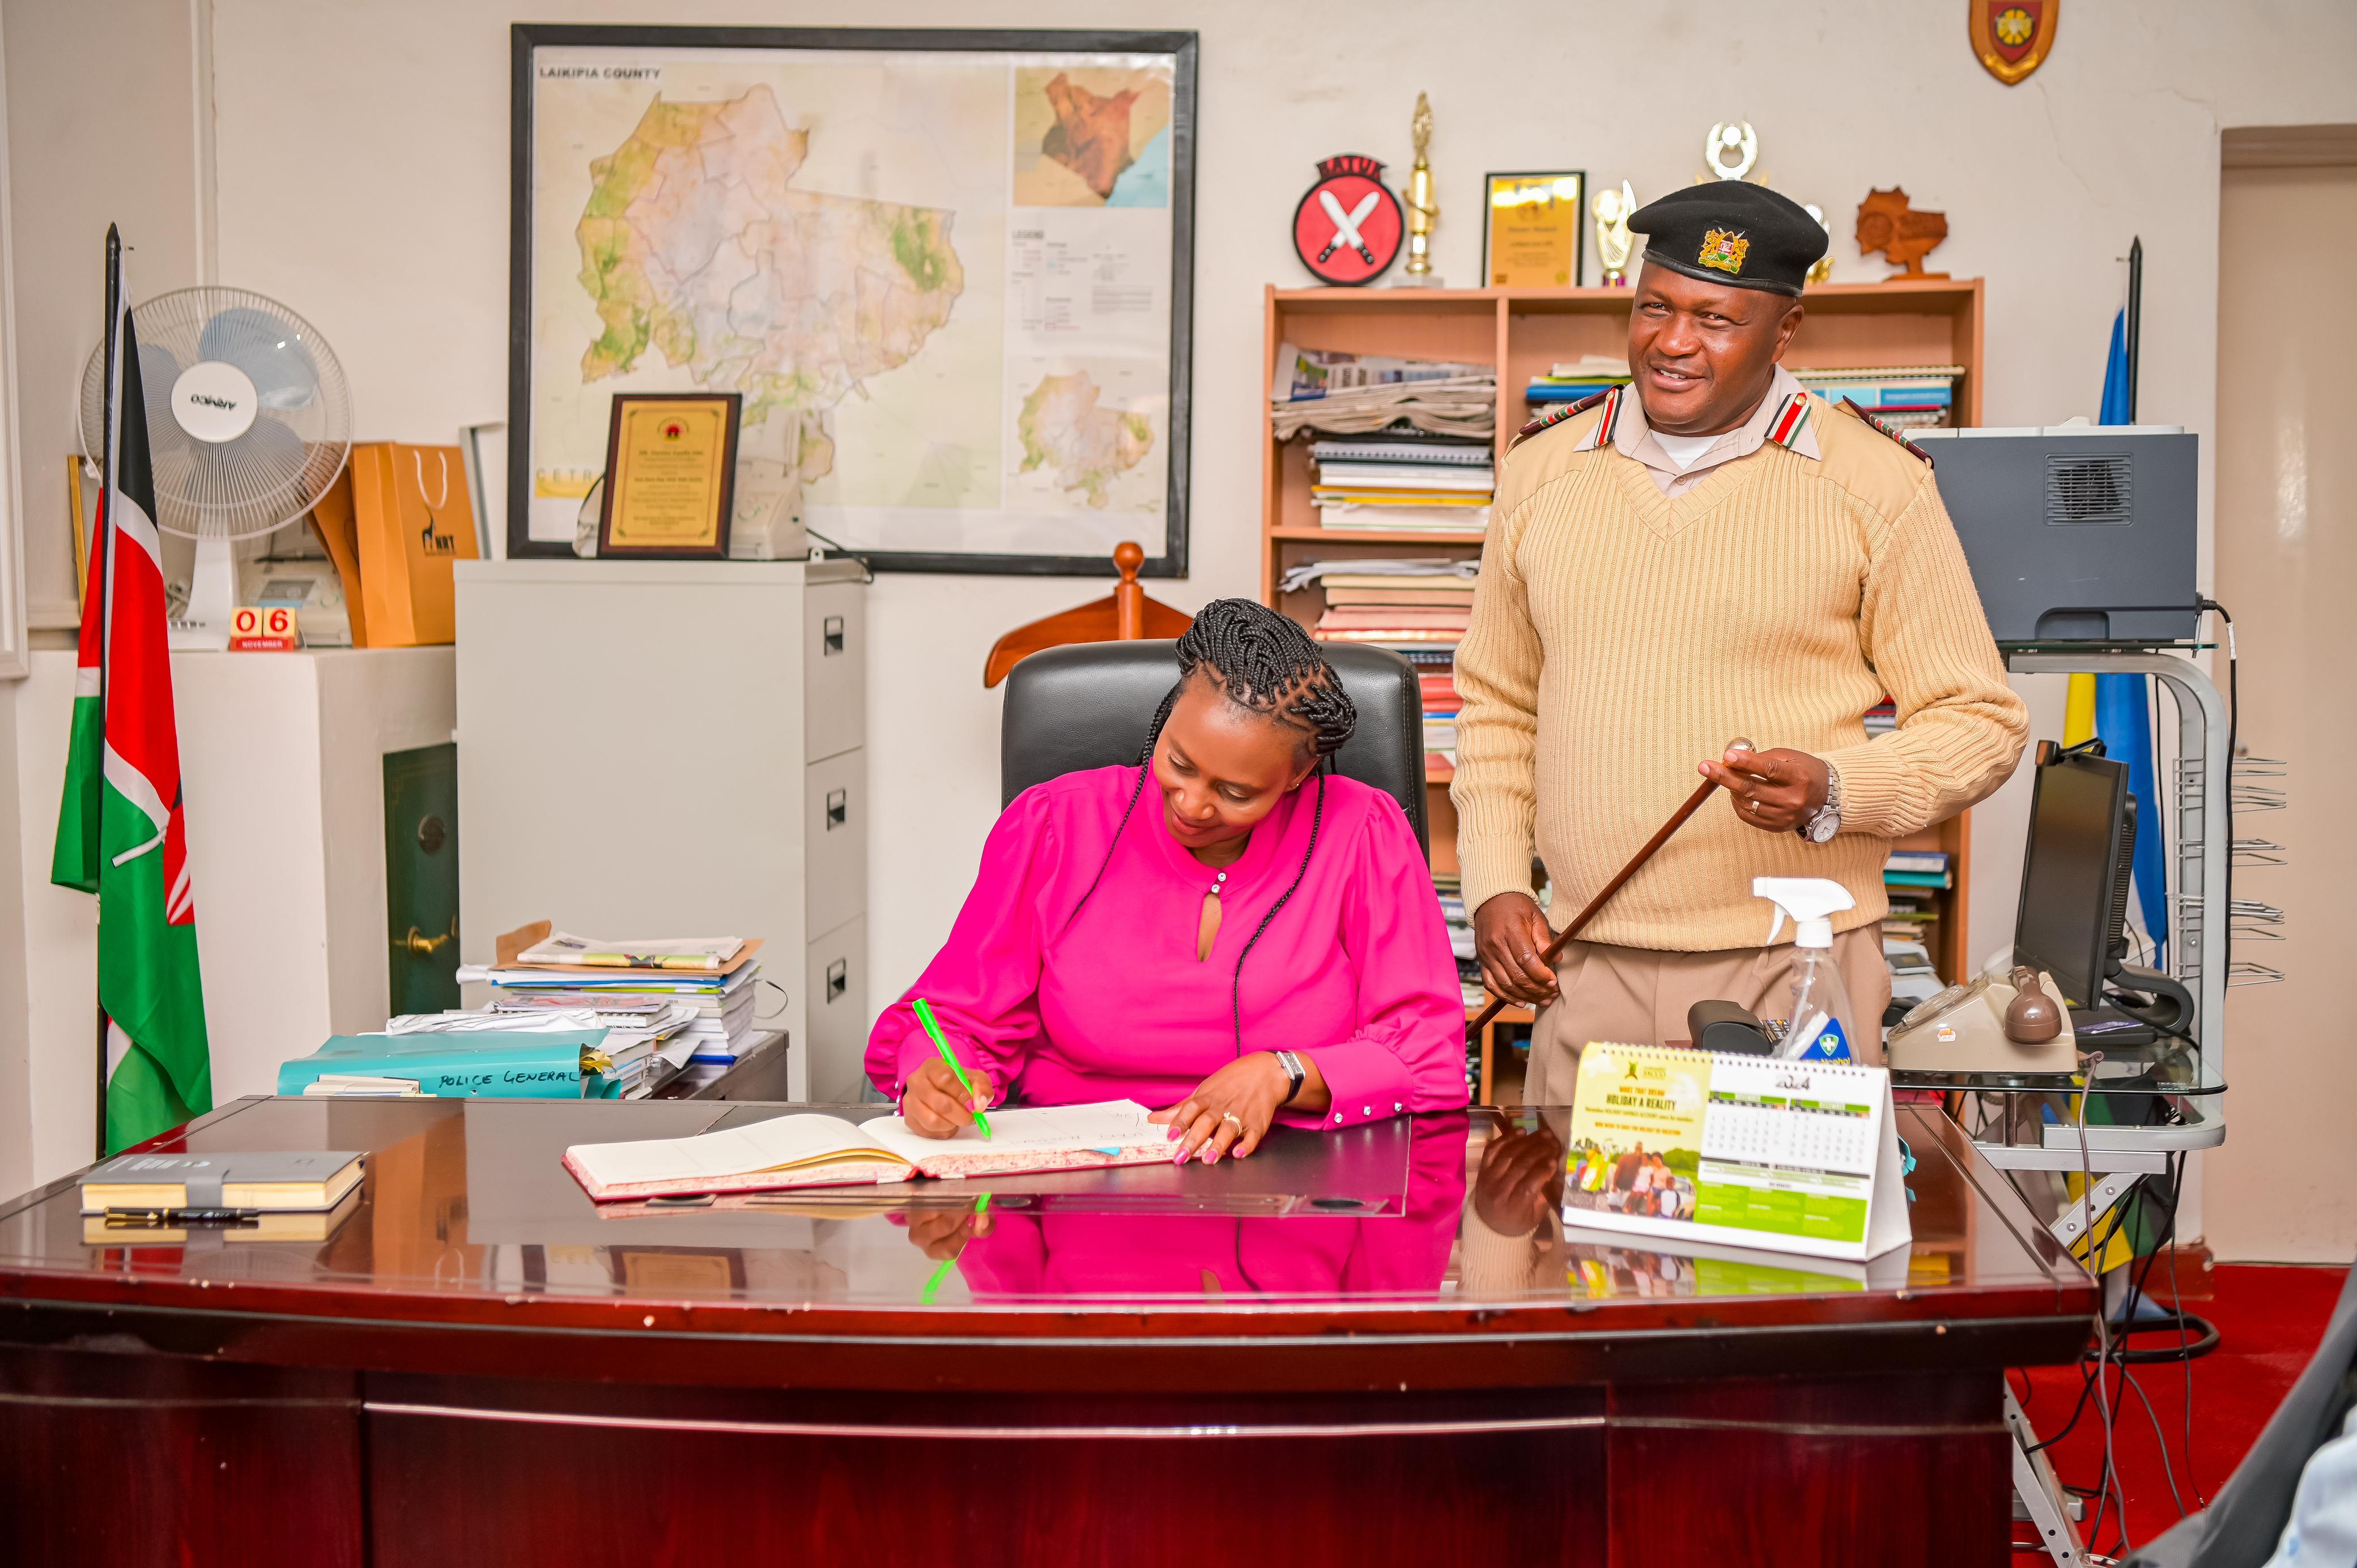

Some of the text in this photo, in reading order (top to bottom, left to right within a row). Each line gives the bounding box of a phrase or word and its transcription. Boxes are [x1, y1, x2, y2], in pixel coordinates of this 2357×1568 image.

[540, 67, 661, 79] LAIKIPIA COUNTY
[536, 467, 593, 483] CETR
[435, 535, 454, 549] NRT
[439, 1070, 580, 1088] POLICE GENERAL
[1606, 1093, 1677, 1111] HOLIDAY A REALITY
